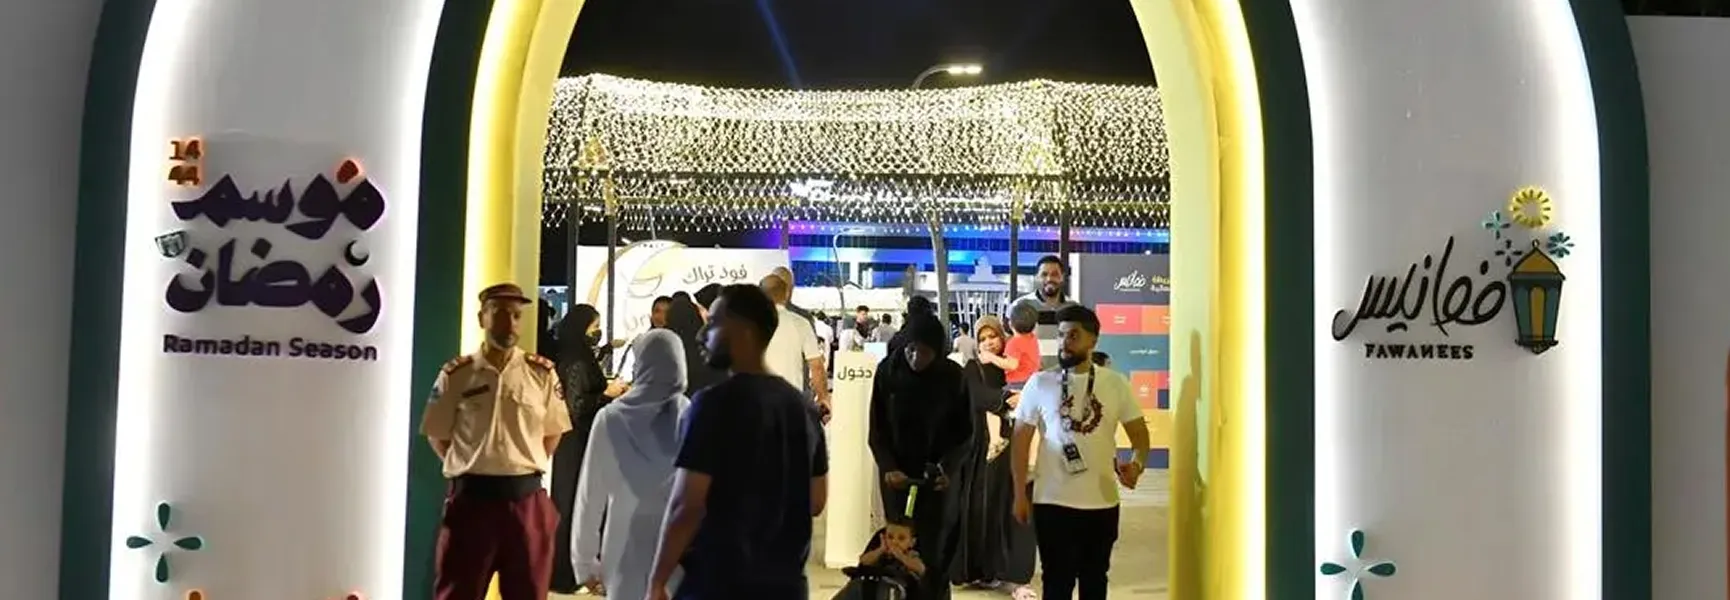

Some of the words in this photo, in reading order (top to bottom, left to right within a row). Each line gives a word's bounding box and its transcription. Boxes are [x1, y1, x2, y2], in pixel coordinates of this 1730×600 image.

[169, 139, 201, 161] 14
[167, 164, 200, 186] 44
[171, 171, 386, 241] موسم
[681, 264, 716, 285] تراك
[718, 263, 748, 283] فود
[165, 238, 382, 334] رمضان
[1331, 235, 1507, 342] فوانيس
[163, 334, 281, 357] Ramadan
[288, 336, 378, 361] Season
[1364, 343, 1474, 360] FAWANEES
[837, 365, 873, 381] دخول
